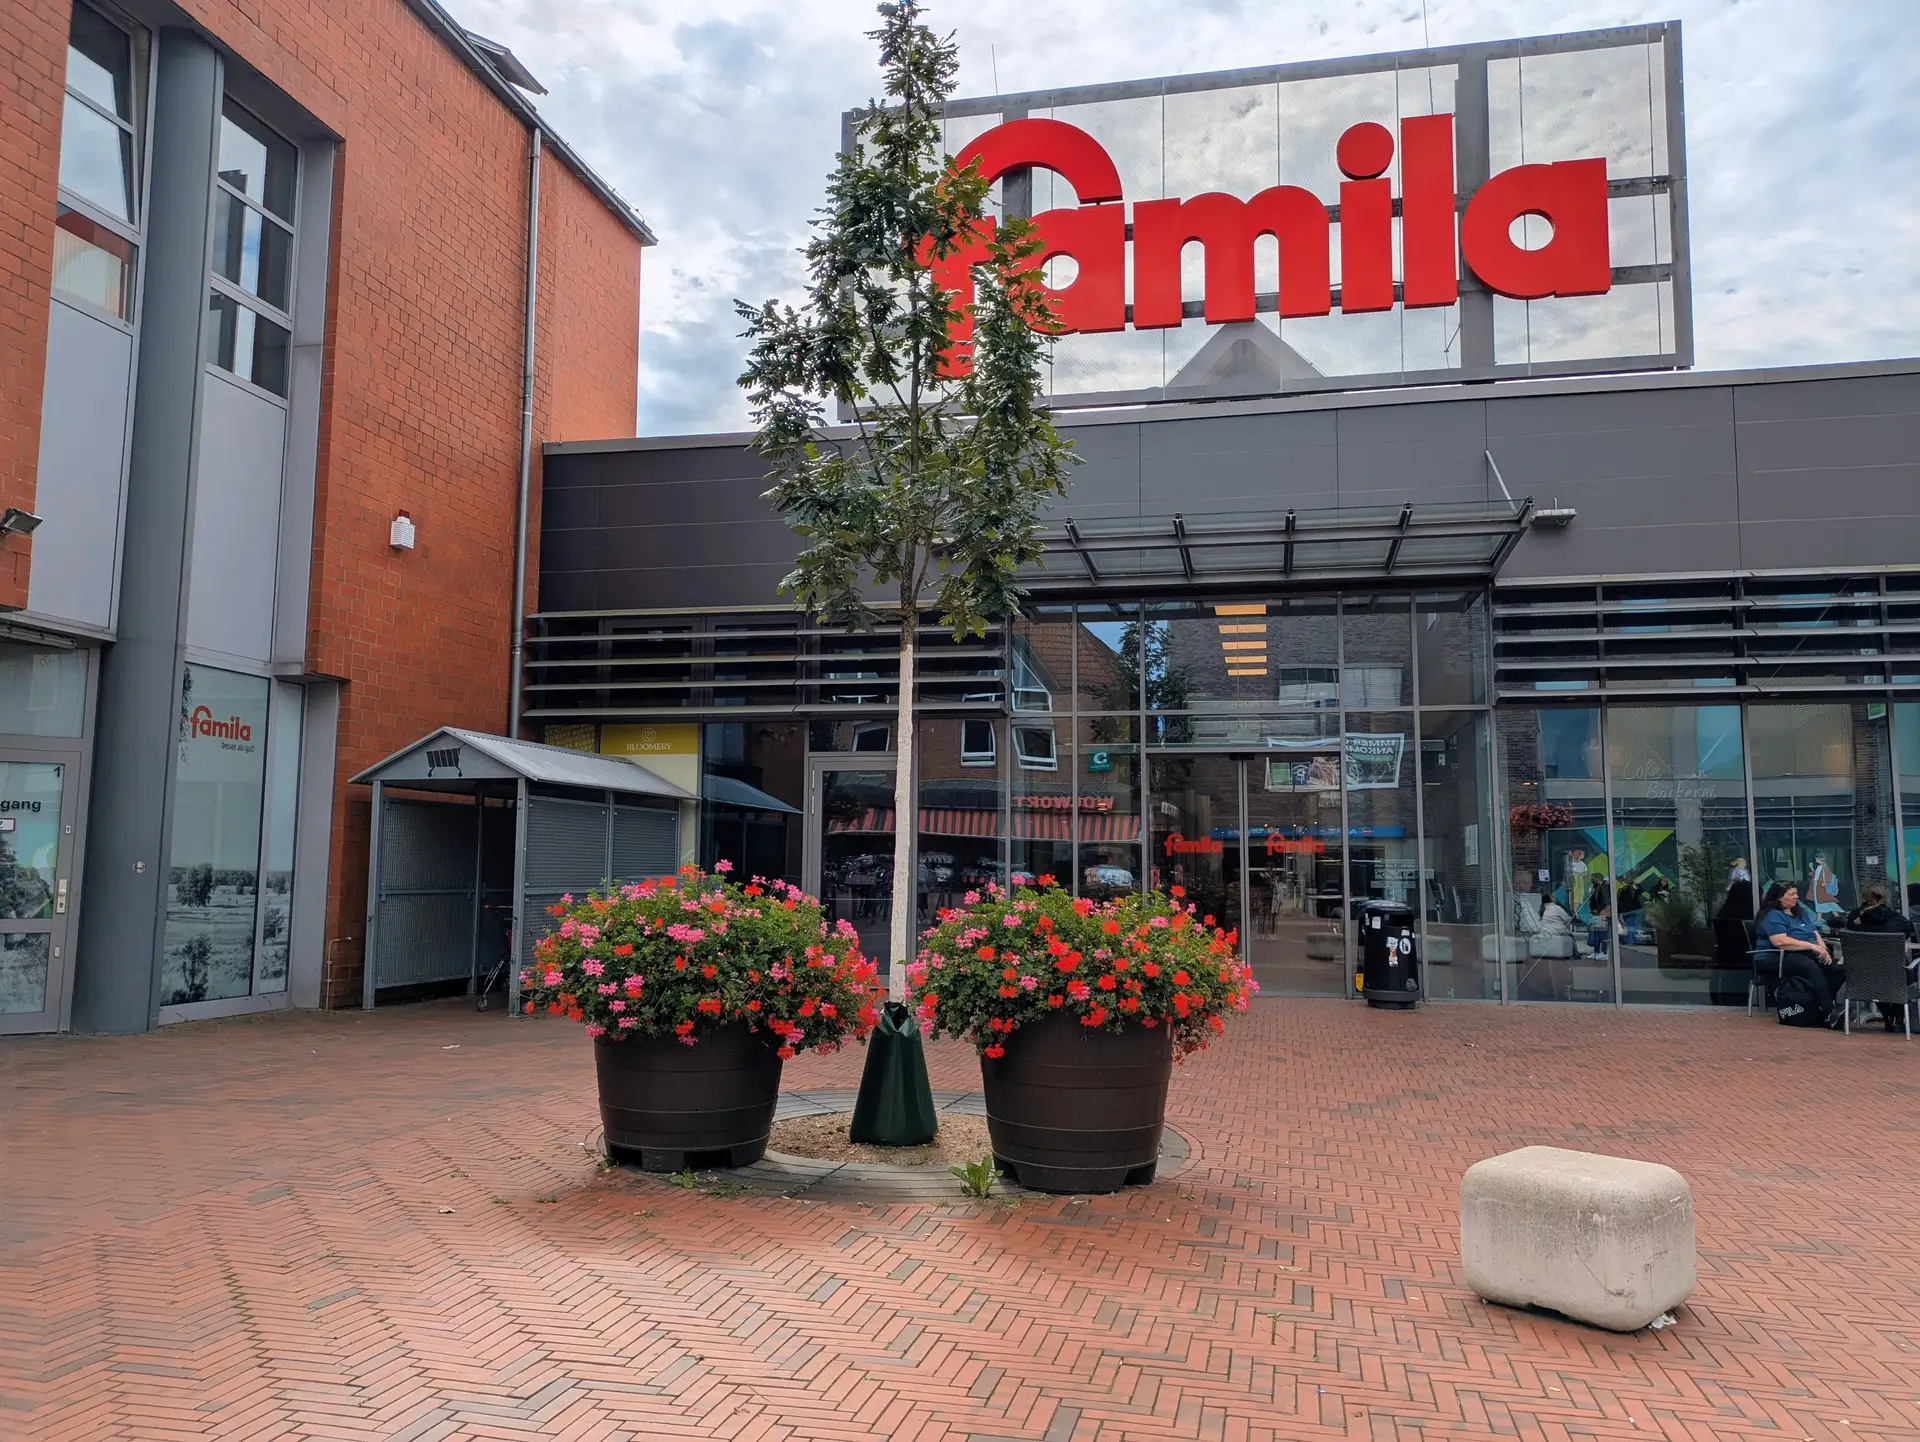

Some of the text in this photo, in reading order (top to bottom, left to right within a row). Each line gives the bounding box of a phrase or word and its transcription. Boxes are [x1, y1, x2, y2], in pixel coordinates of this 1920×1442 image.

[915, 114, 1611, 378] famila
[190, 705, 251, 742] famila
[626, 742, 672, 751] BLOOMERY
[54, 766, 61, 778] 1
[1164, 832, 1223, 857] famila
[1264, 832, 1325, 856] famila
